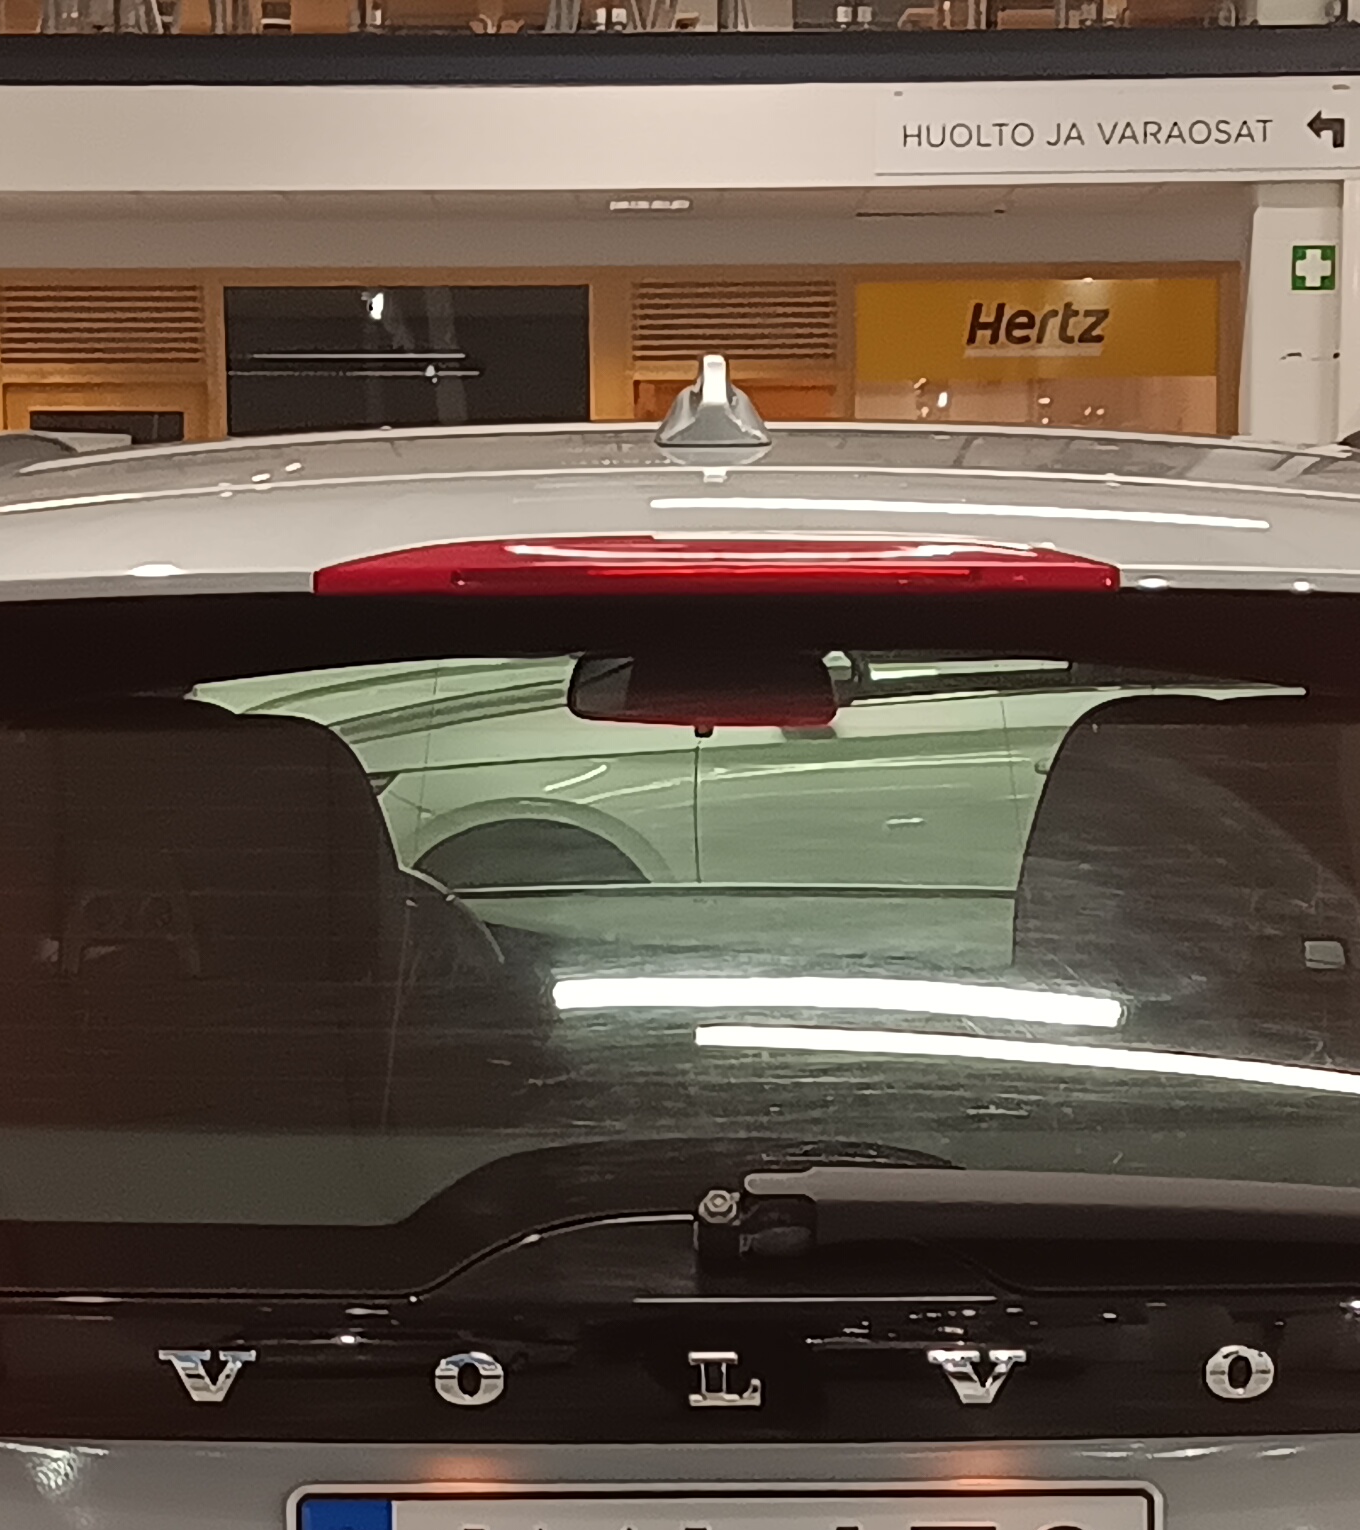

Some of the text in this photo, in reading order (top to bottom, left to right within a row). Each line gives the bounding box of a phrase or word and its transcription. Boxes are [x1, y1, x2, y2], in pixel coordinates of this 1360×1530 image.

[902, 119, 1274, 148] HUOLTO JA VARAOSAT
[966, 301, 1110, 345] Hertz
[158, 1344, 1275, 1407] VOLVO
